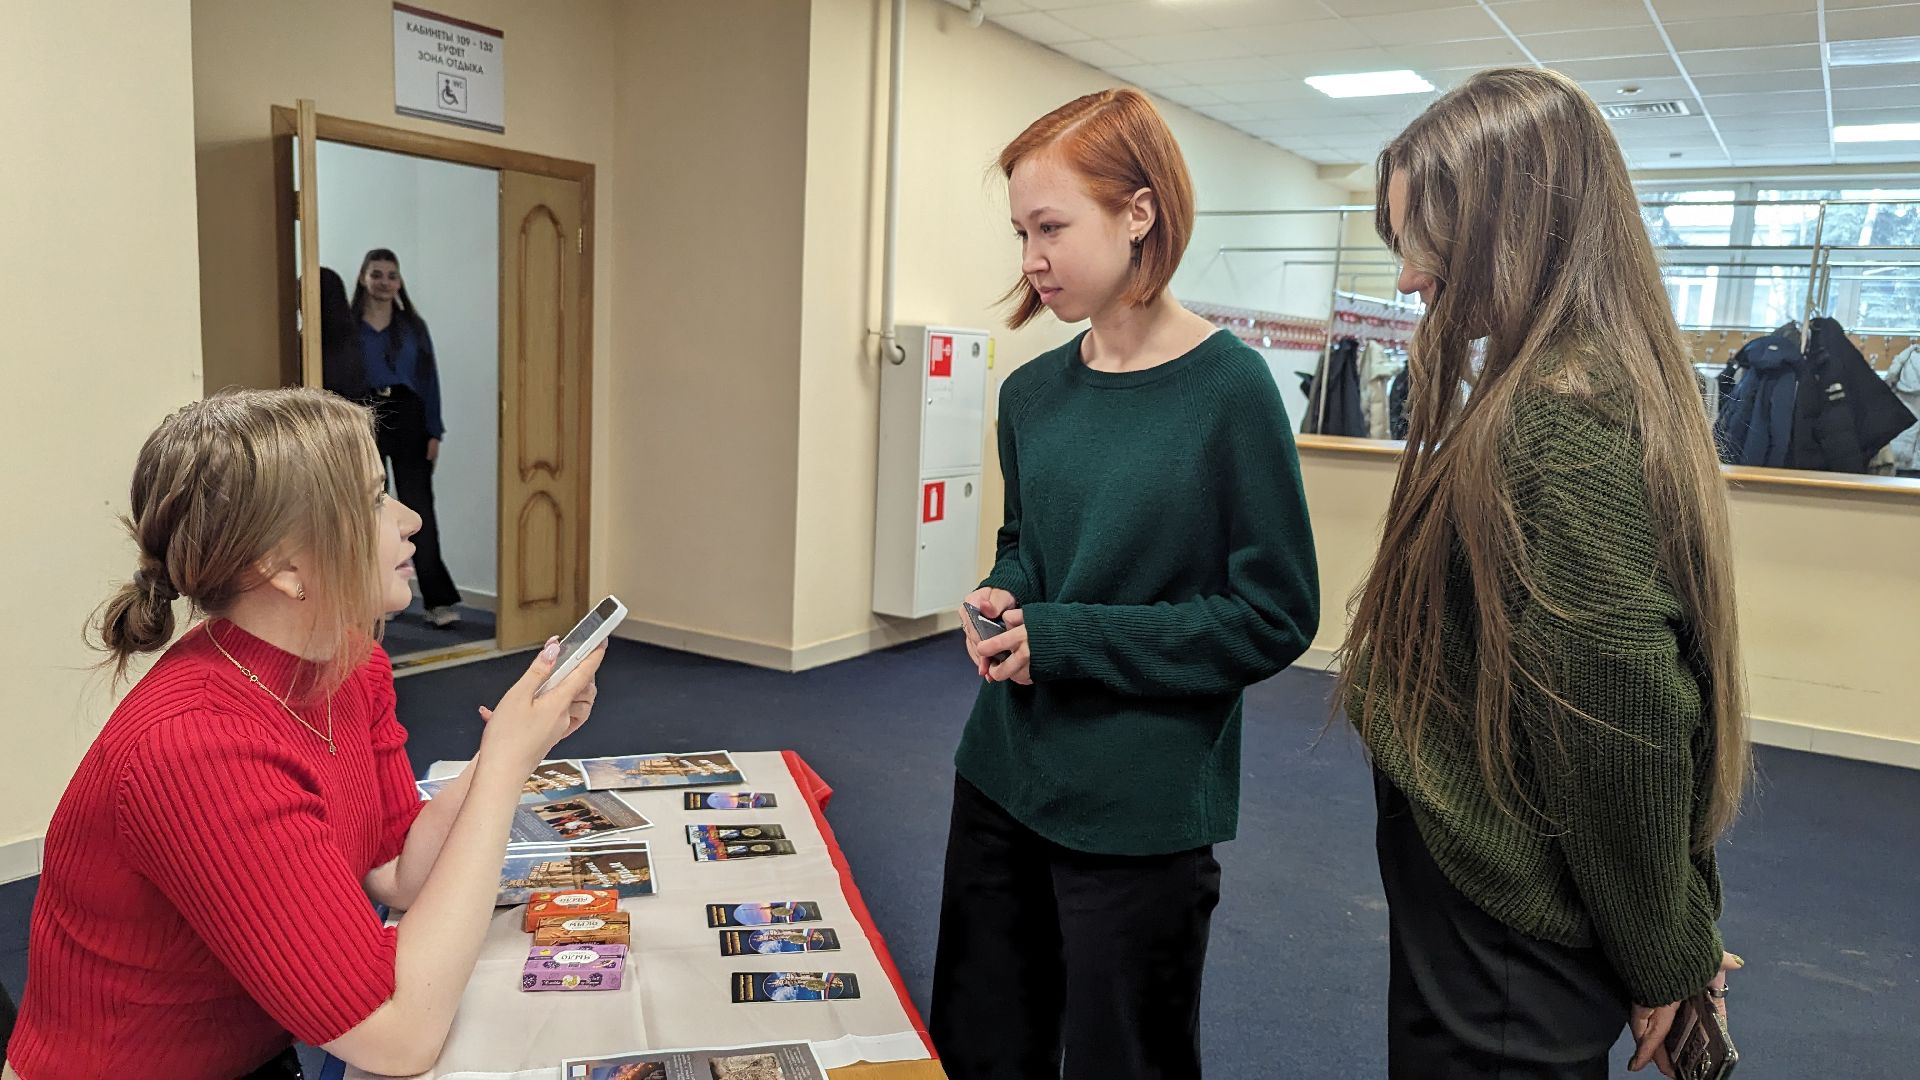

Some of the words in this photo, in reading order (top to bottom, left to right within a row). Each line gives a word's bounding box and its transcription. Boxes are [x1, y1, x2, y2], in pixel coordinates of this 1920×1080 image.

[406, 22, 454, 41] КАБИНЕТЫ
[457, 35, 471, 46] 109
[480, 40, 494, 52] 132
[438, 42, 465, 57] БУФЕТ
[418, 50, 443, 64] ЗОНА
[447, 58, 484, 74] ОТДЫХА
